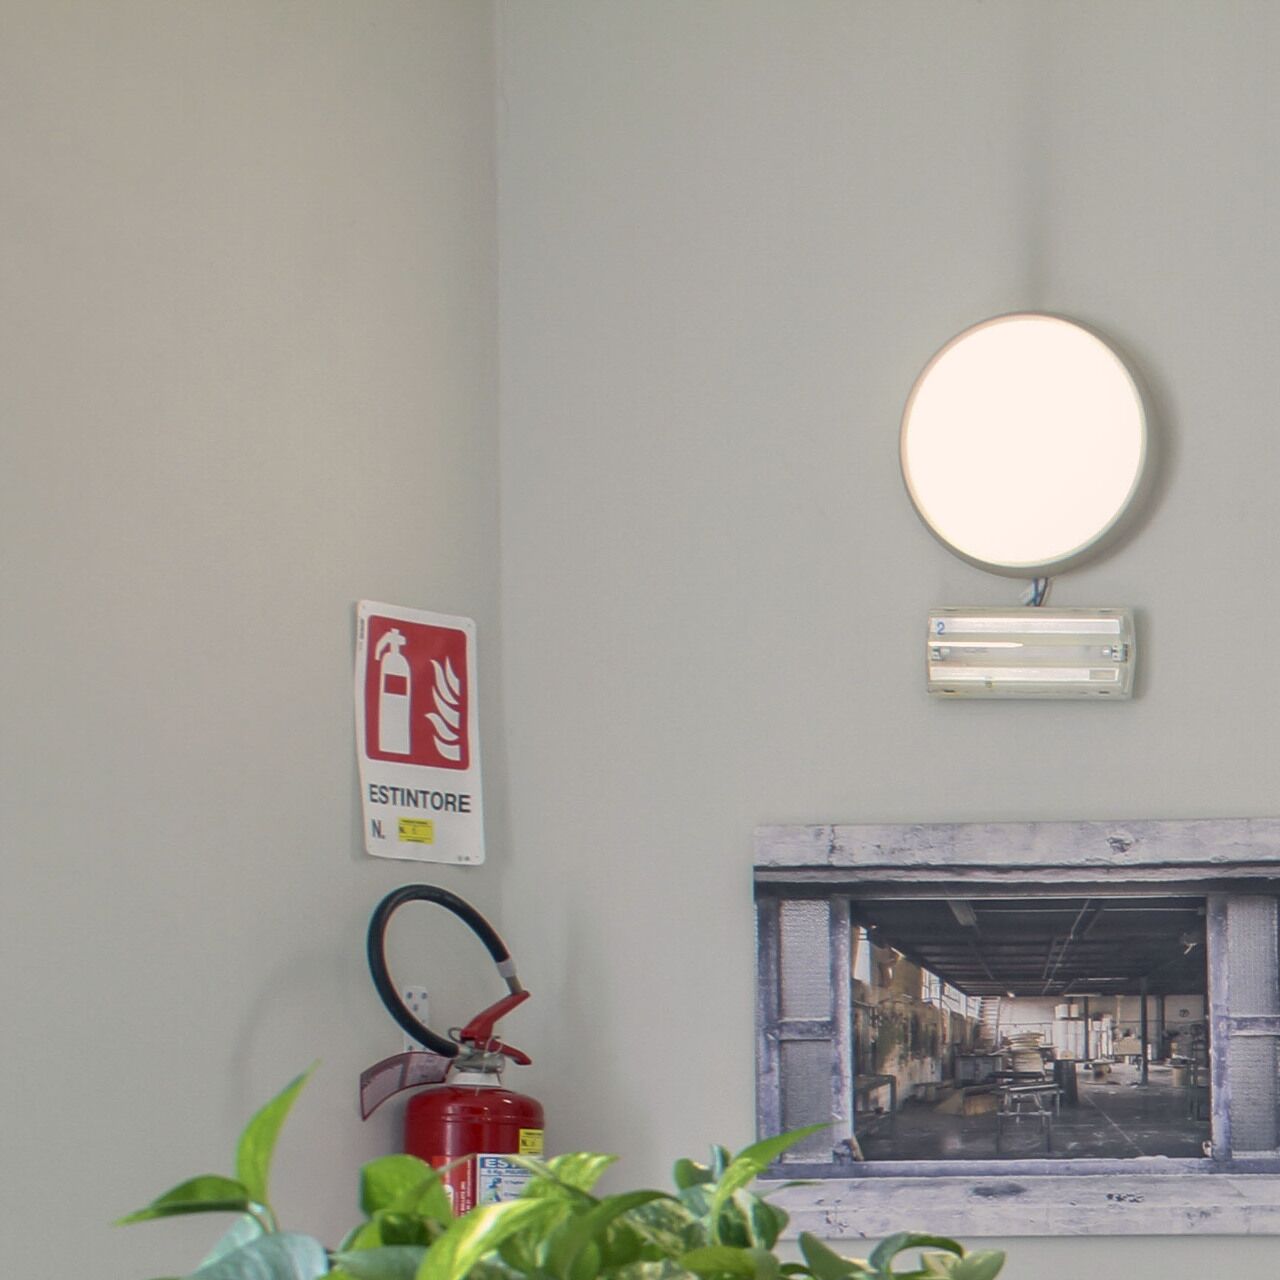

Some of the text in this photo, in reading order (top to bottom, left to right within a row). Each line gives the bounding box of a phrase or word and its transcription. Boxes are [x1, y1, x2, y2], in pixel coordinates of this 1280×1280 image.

[936, 621, 945, 635] 2
[368, 783, 471, 813] ESTINTORE
[371, 818, 386, 839] N.
